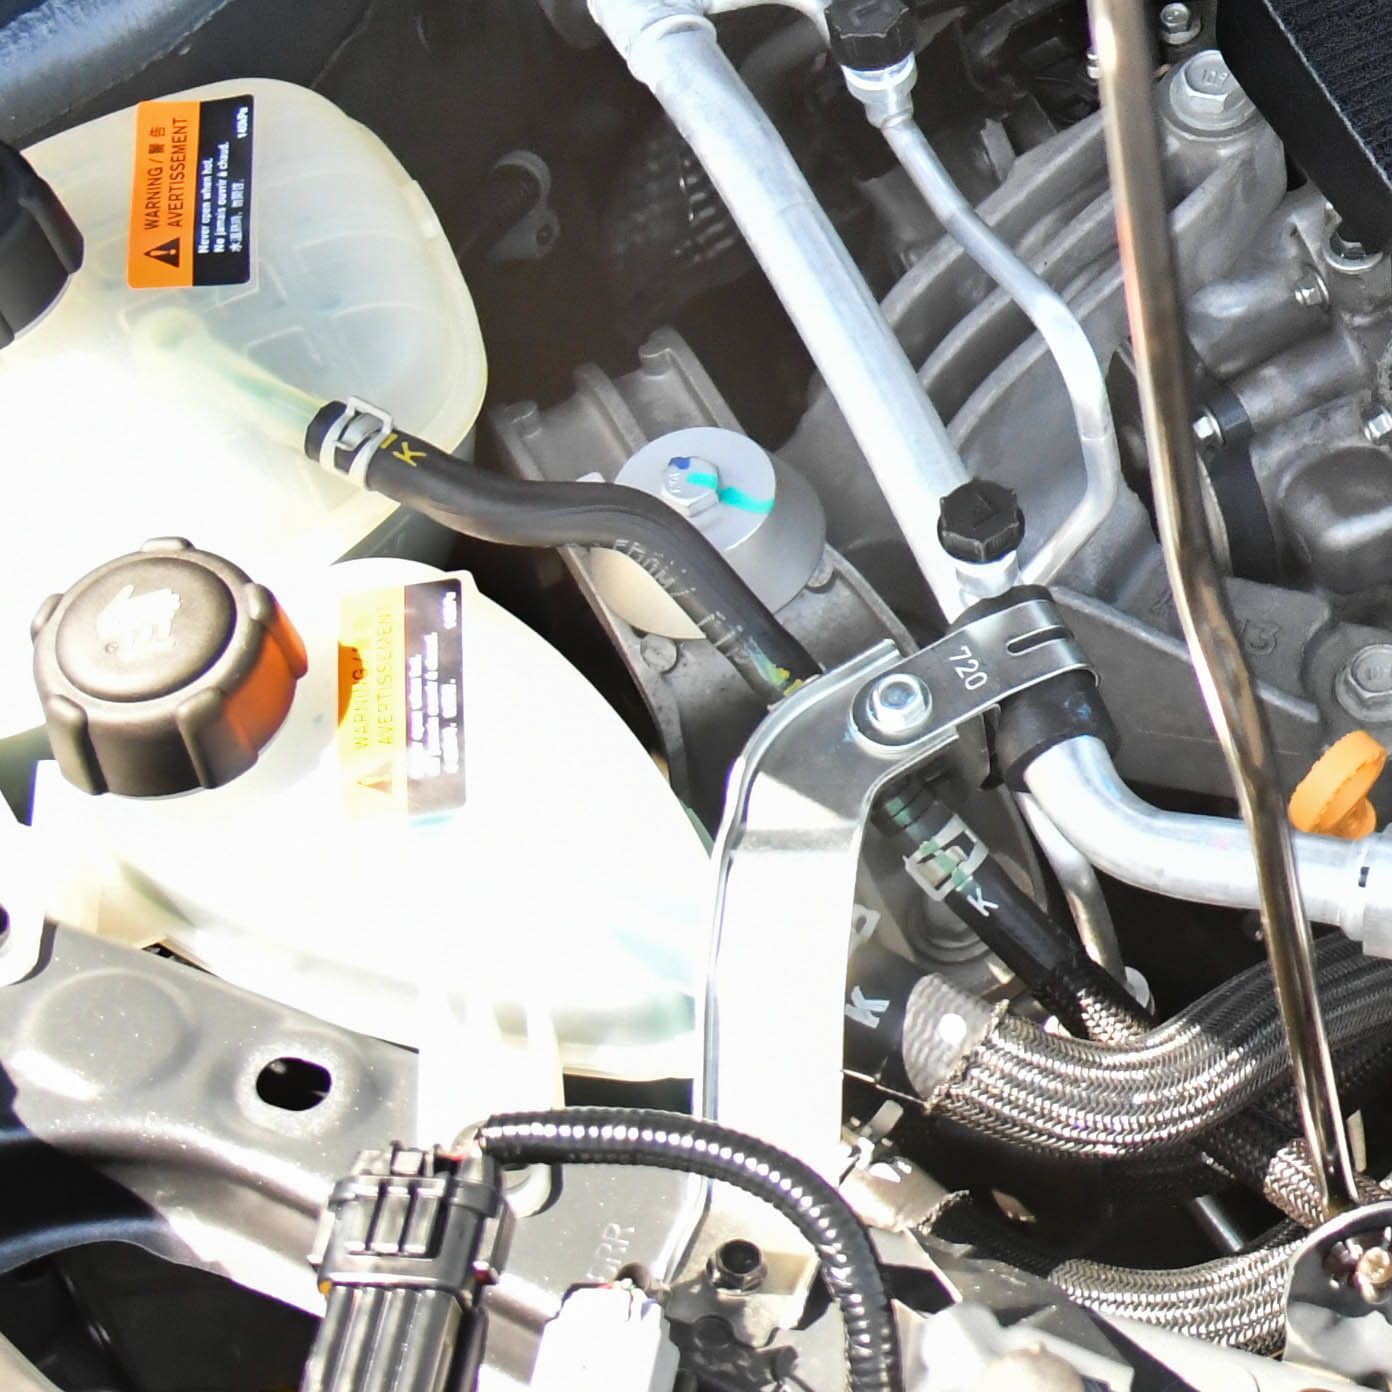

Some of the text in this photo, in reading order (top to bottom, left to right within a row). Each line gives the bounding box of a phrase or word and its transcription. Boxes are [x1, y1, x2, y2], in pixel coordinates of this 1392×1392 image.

[168, 117, 187, 226] AVERTISSEMENT
[218, 141, 229, 168] chaud.
[143, 167, 162, 229] WARNING
[198, 157, 213, 253] Never open when hot.
[216, 179, 226, 204] ouvrir
[215, 207, 226, 235] jamais
[392, 441, 427, 467] K
[949, 645, 988, 690] 720
[967, 887, 999, 917] K
[845, 985, 890, 1029] K
